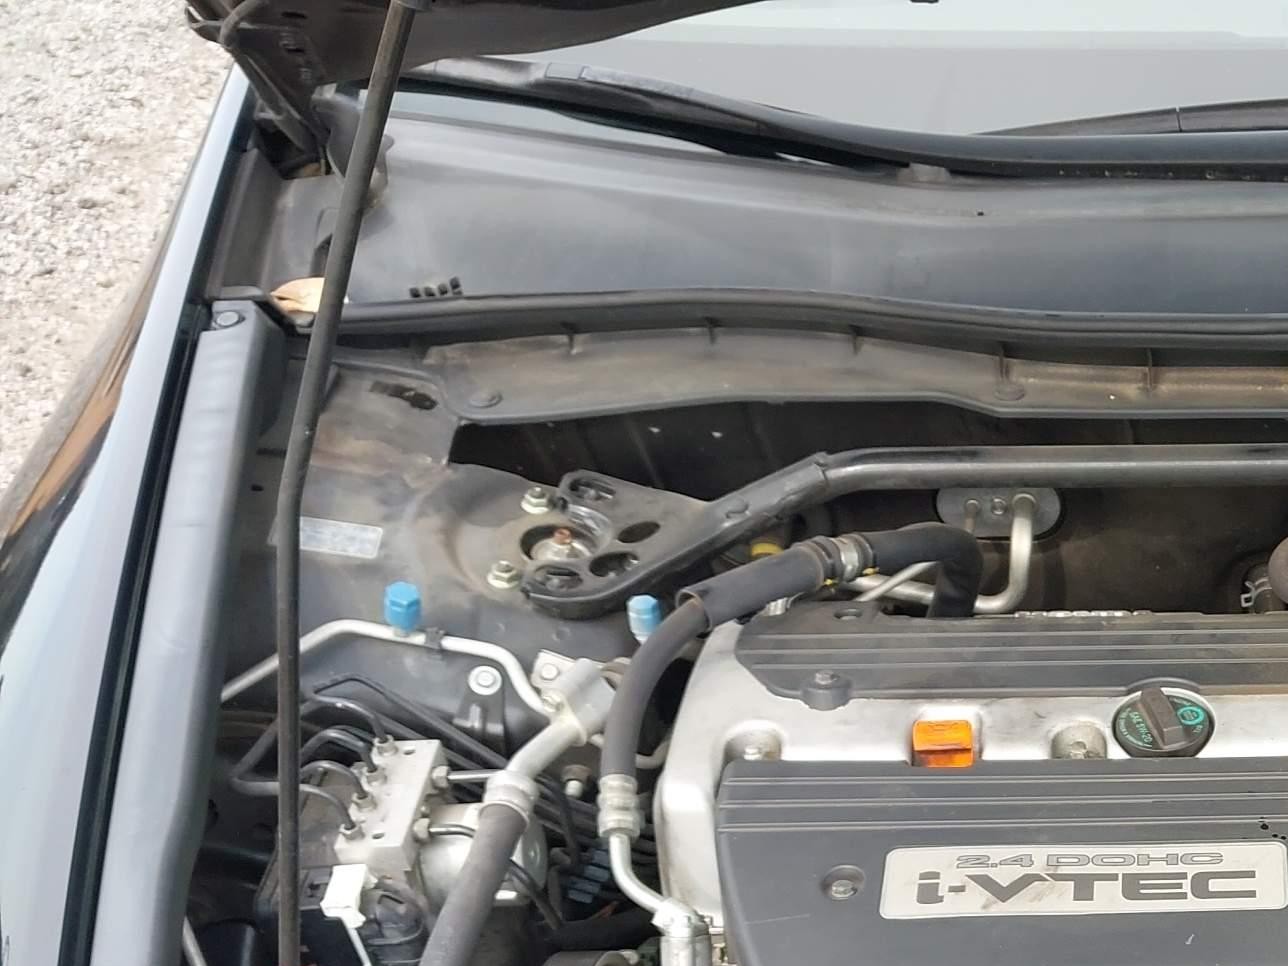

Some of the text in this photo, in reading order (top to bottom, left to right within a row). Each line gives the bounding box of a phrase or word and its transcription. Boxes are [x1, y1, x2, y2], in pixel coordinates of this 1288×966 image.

[956, 853, 1224, 868] 2.4 DOHC
[916, 870, 1257, 905] i-VTEC
